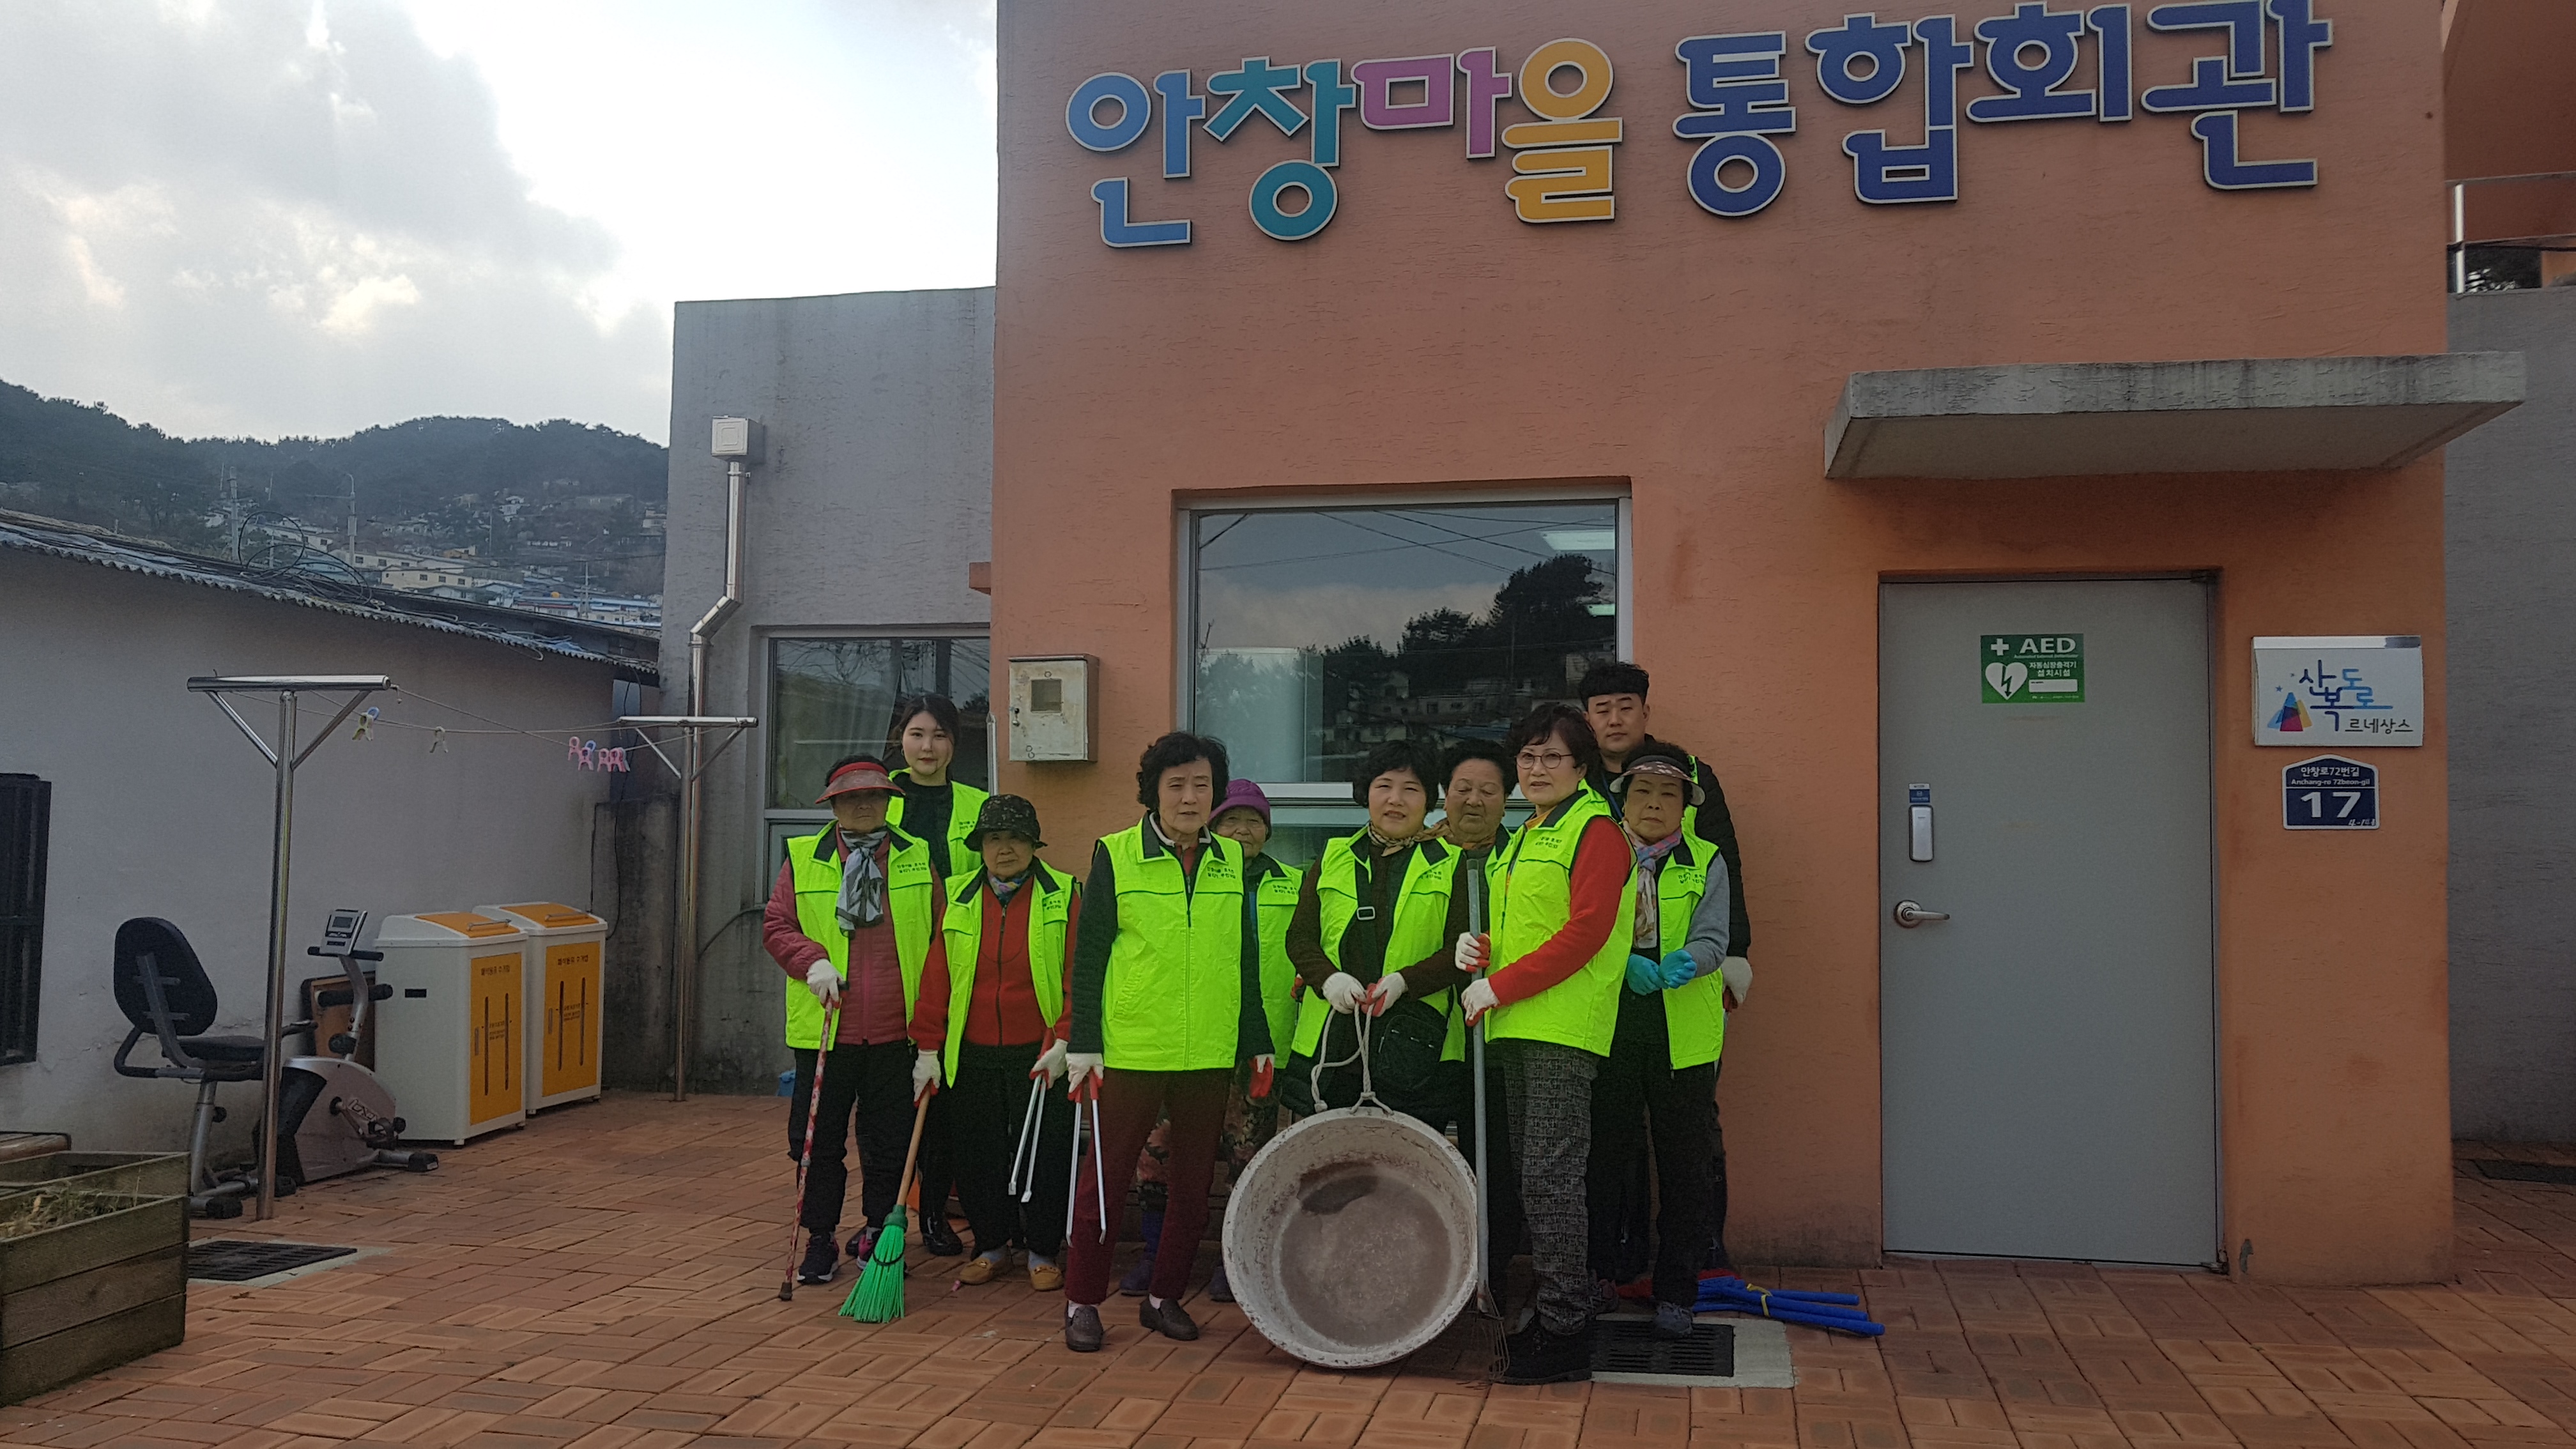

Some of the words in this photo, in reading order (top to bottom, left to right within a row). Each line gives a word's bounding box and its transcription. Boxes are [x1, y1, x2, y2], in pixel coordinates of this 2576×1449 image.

[1064, 36, 1625, 250] 안창마을
[1672, 0, 2334, 218] 통합회관
[2020, 638, 2076, 654] AED
[2344, 718, 2414, 735] 르네상스
[2301, 767, 2360, 778] 안창로72번길
[2301, 792, 2361, 818] 17
